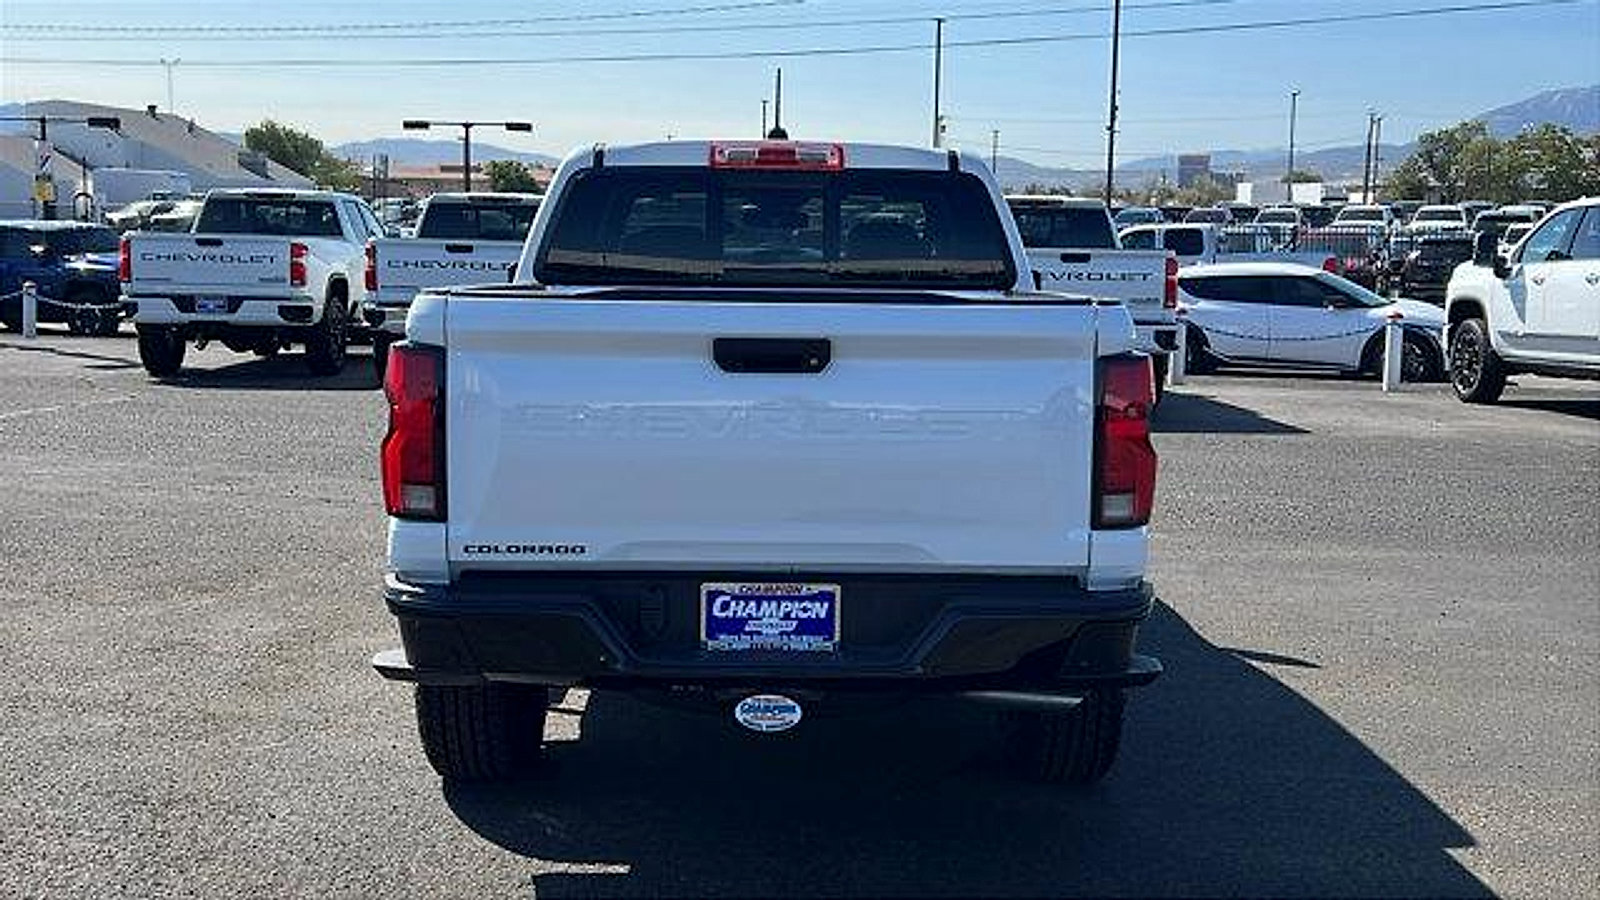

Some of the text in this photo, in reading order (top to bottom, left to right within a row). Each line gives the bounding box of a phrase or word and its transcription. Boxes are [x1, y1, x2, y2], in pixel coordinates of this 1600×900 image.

[140, 252, 276, 264] CHEVROLET
[387, 260, 512, 271] CHEVROL
[1042, 271, 1152, 281] VROLET
[463, 544, 586, 554] COLORADO
[712, 596, 829, 618] CHAMPION
